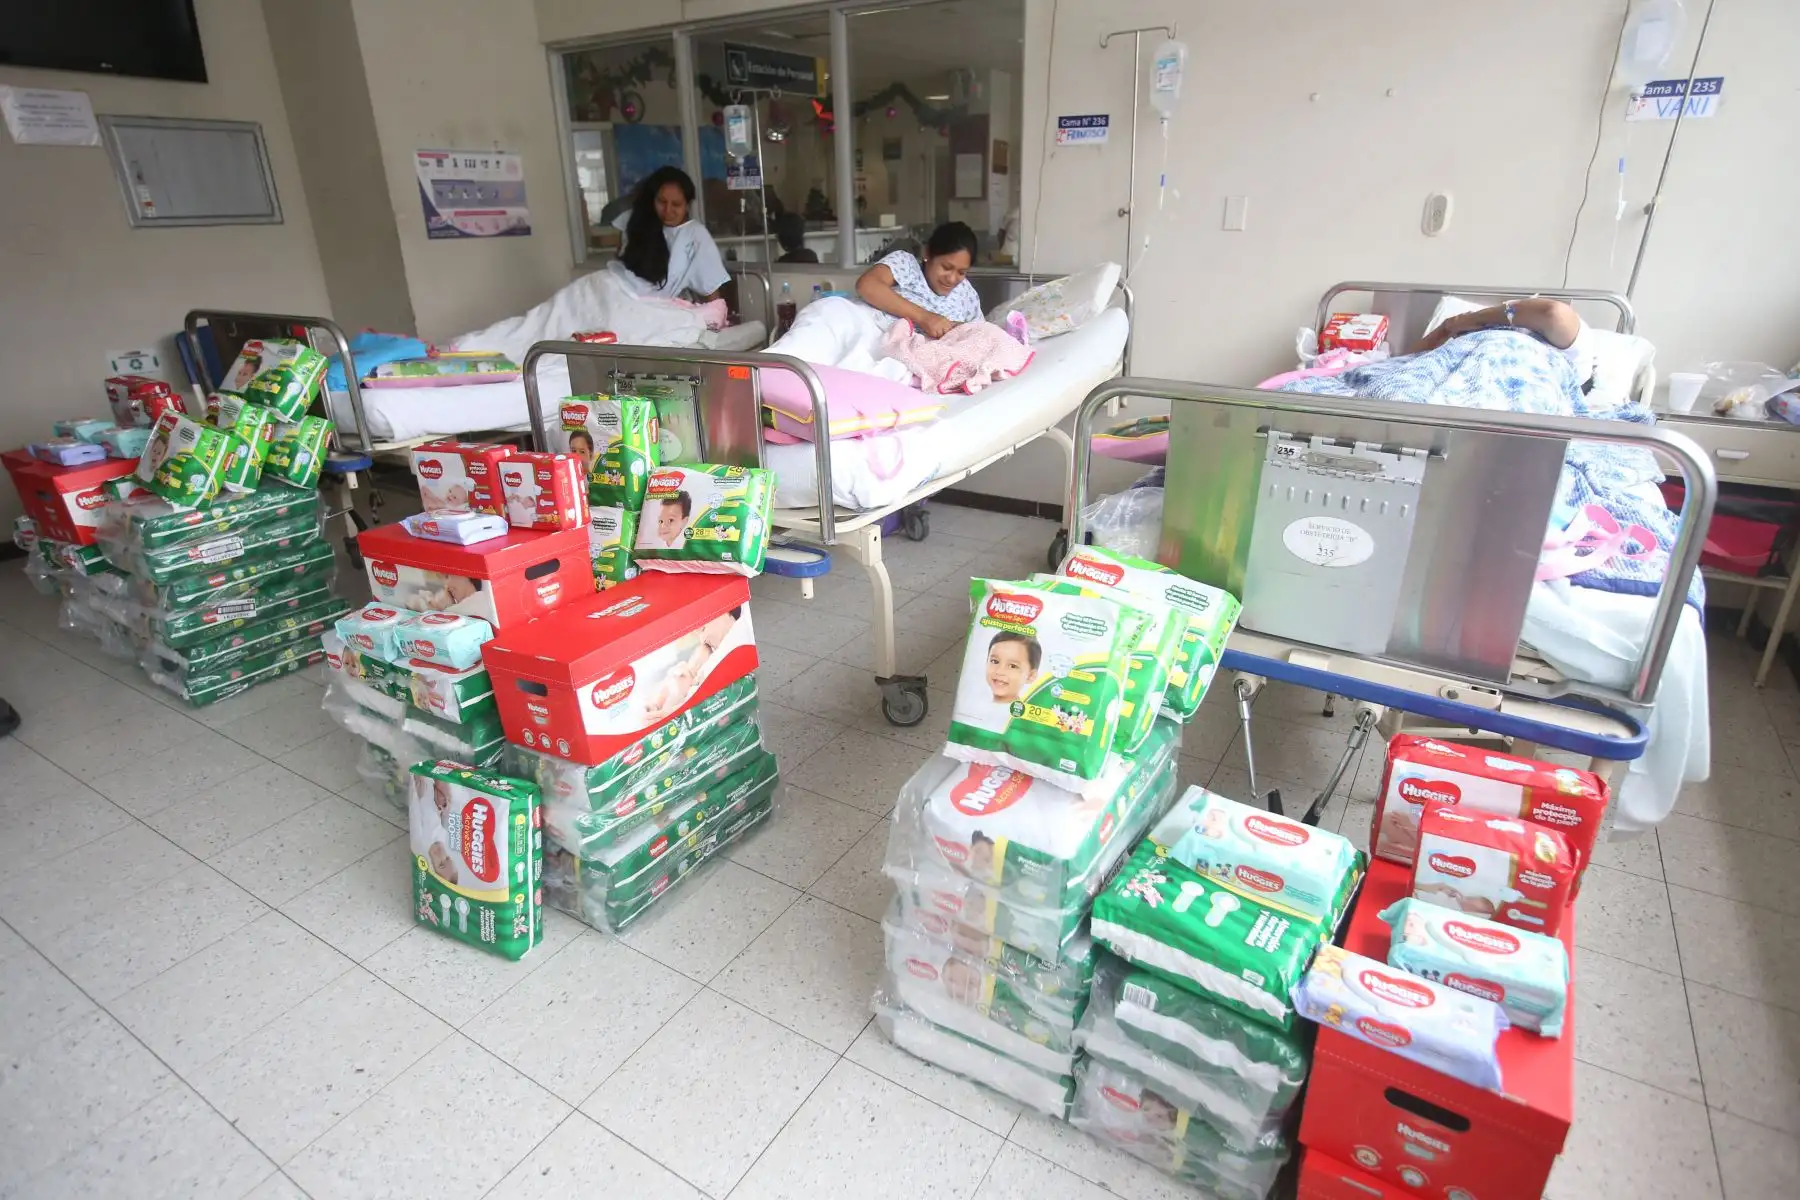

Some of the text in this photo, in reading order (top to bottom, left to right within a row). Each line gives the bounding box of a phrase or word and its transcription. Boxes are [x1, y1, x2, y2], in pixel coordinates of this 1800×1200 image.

[748, 61, 777, 75] Estación
[777, 66, 786, 76] de
[1693, 81, 1717, 93] 235
[1656, 97, 1710, 118] VANI
[1061, 118, 1082, 128] Cama
[1092, 116, 1107, 126] 236
[562, 410, 586, 421] HUGGIES
[1277, 445, 1295, 456] 235
[420, 465, 442, 475] HUGGIES
[650, 479, 680, 487] HUGGIES
[1300, 529, 1345, 541] OBSTETRICIA
[1308, 522, 1351, 535] SERVICIO DE
[1316, 547, 1335, 558] 235
[373, 566, 397, 581] HUGGIES
[1069, 560, 1117, 586] HUGGIES
[990, 597, 1037, 618] HUGGIES
[982, 618, 1036, 636] ajuste perfecto
[593, 674, 634, 704] HUGGIES
[527, 702, 549, 715] HUGGIES
[1028, 706, 1042, 716] 20
[959, 765, 1014, 812] HUGG
[1402, 783, 1456, 804] HUGGIES
[1533, 808, 1583, 823] protección
[1541, 802, 1577, 815] Máxima
[1534, 814, 1547, 822] de
[1548, 815, 1556, 823] la
[472, 803, 488, 874] HUGGIES
[463, 841, 471, 856] Sec
[650, 840, 668, 856] HUGGIES
[1432, 857, 1473, 875] HUGGIES
[1238, 868, 1280, 890] HUGGIES
[1448, 922, 1516, 951] HUGGIES
[1364, 975, 1429, 1005] HUGGIES
[1448, 976, 1500, 1002] HUGGIES
[1360, 1020, 1406, 1045] HUGGIES
[1396, 1122, 1450, 1152] HUGGIES
